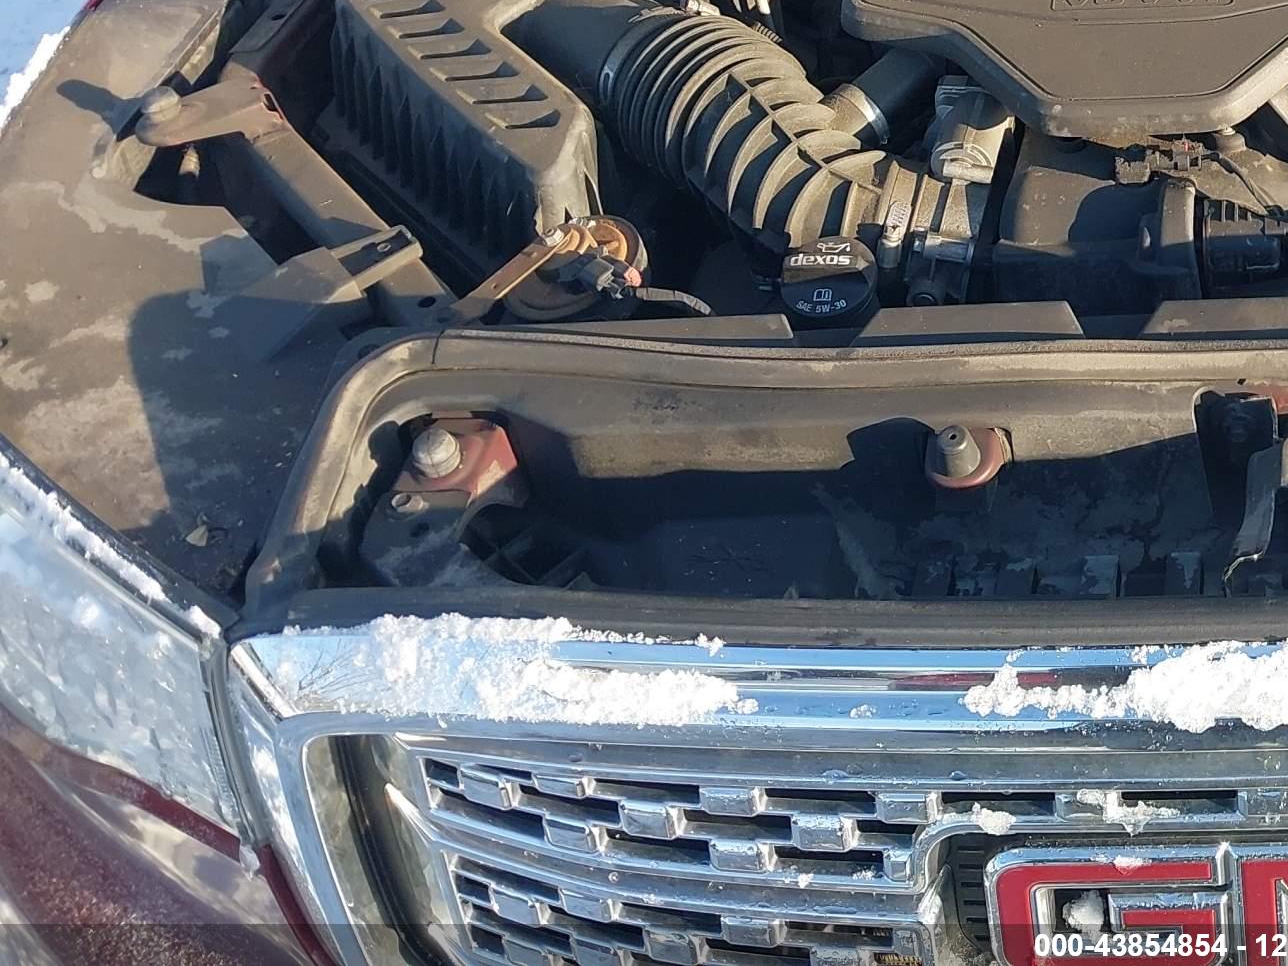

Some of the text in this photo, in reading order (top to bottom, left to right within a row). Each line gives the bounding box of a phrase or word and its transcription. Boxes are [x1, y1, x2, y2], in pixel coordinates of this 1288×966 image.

[789, 253, 854, 267] dexos
[796, 299, 847, 313] SAE 5W-30
